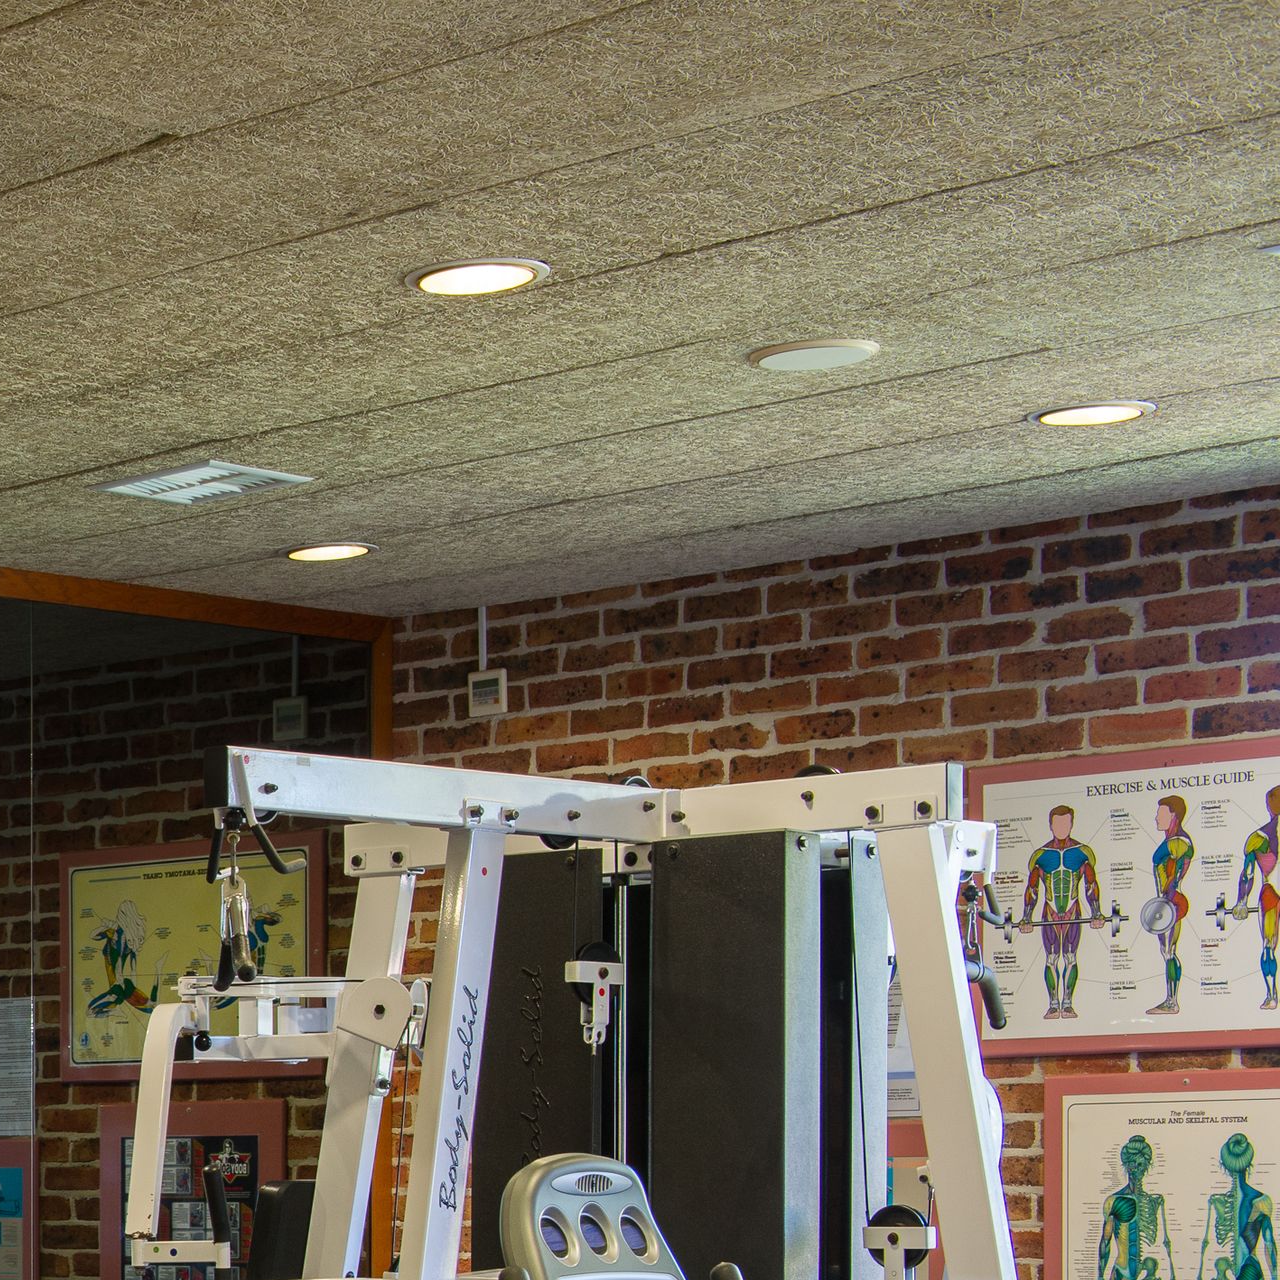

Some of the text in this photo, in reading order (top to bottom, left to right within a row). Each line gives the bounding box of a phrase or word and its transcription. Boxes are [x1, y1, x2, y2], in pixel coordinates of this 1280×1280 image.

[1086, 770, 1255, 797] EXERCISE & MUSCLE GUIDE
[439, 984, 478, 1212] Body-Solid
